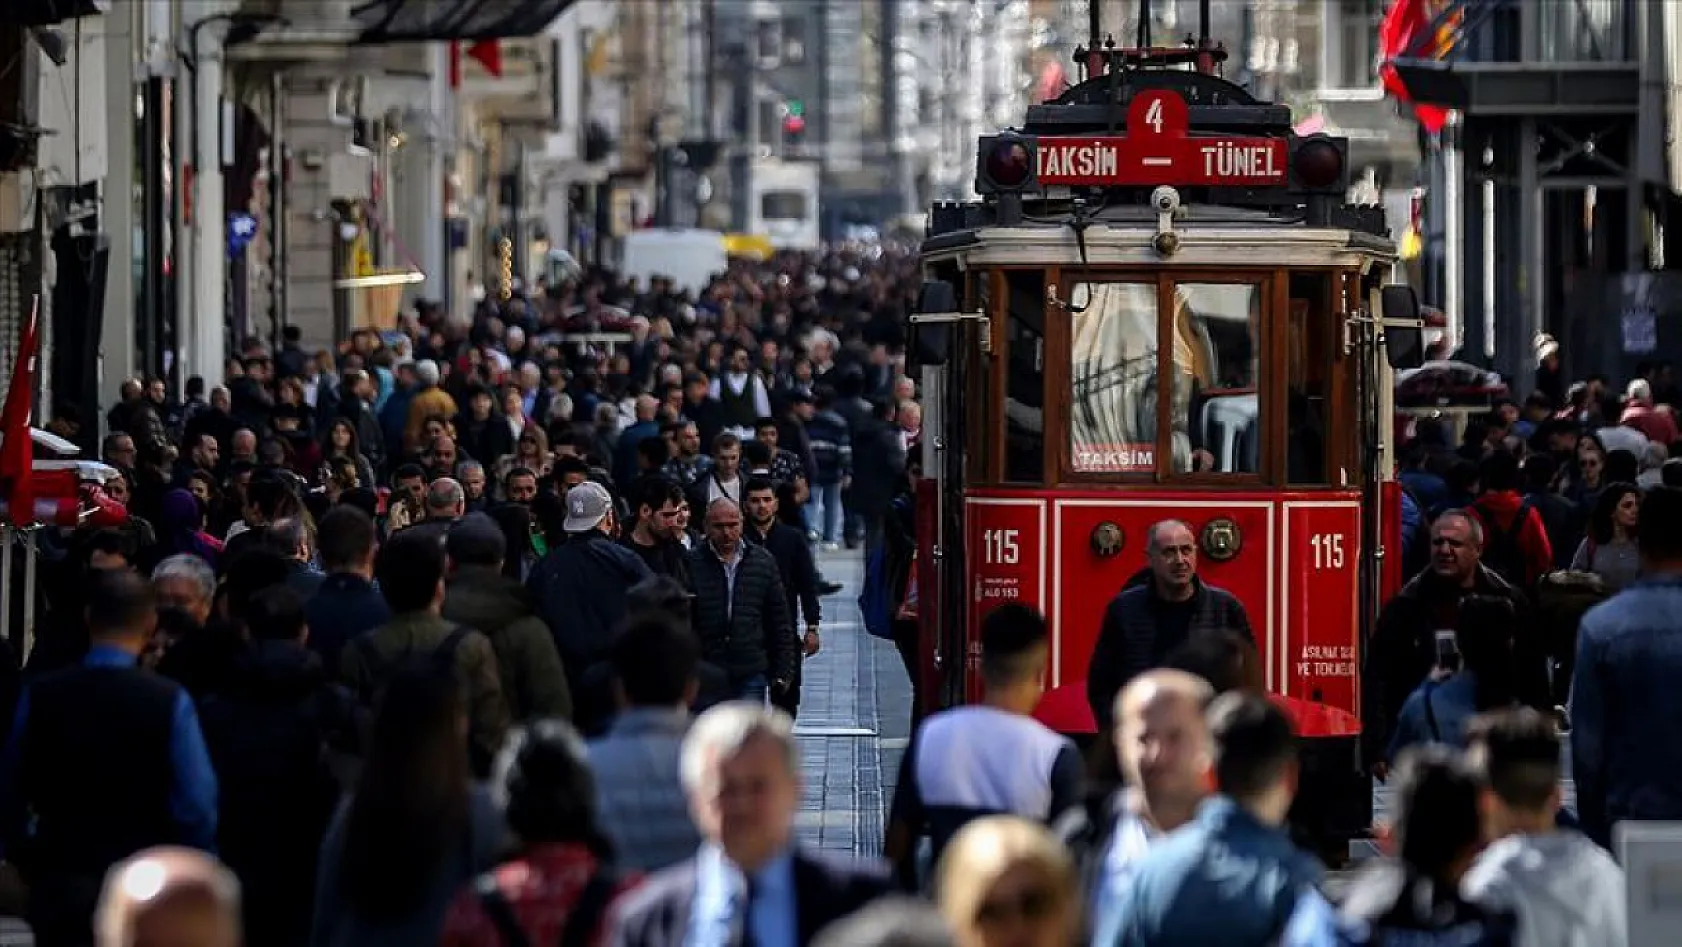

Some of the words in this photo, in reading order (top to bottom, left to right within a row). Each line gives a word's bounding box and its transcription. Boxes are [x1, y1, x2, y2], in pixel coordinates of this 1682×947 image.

[1145, 98, 1164, 134] 4
[1036, 141, 1118, 176] TAKSİM
[1201, 141, 1283, 176] TÜNEL
[984, 529, 1019, 564] 115
[1311, 533, 1344, 569] 115
